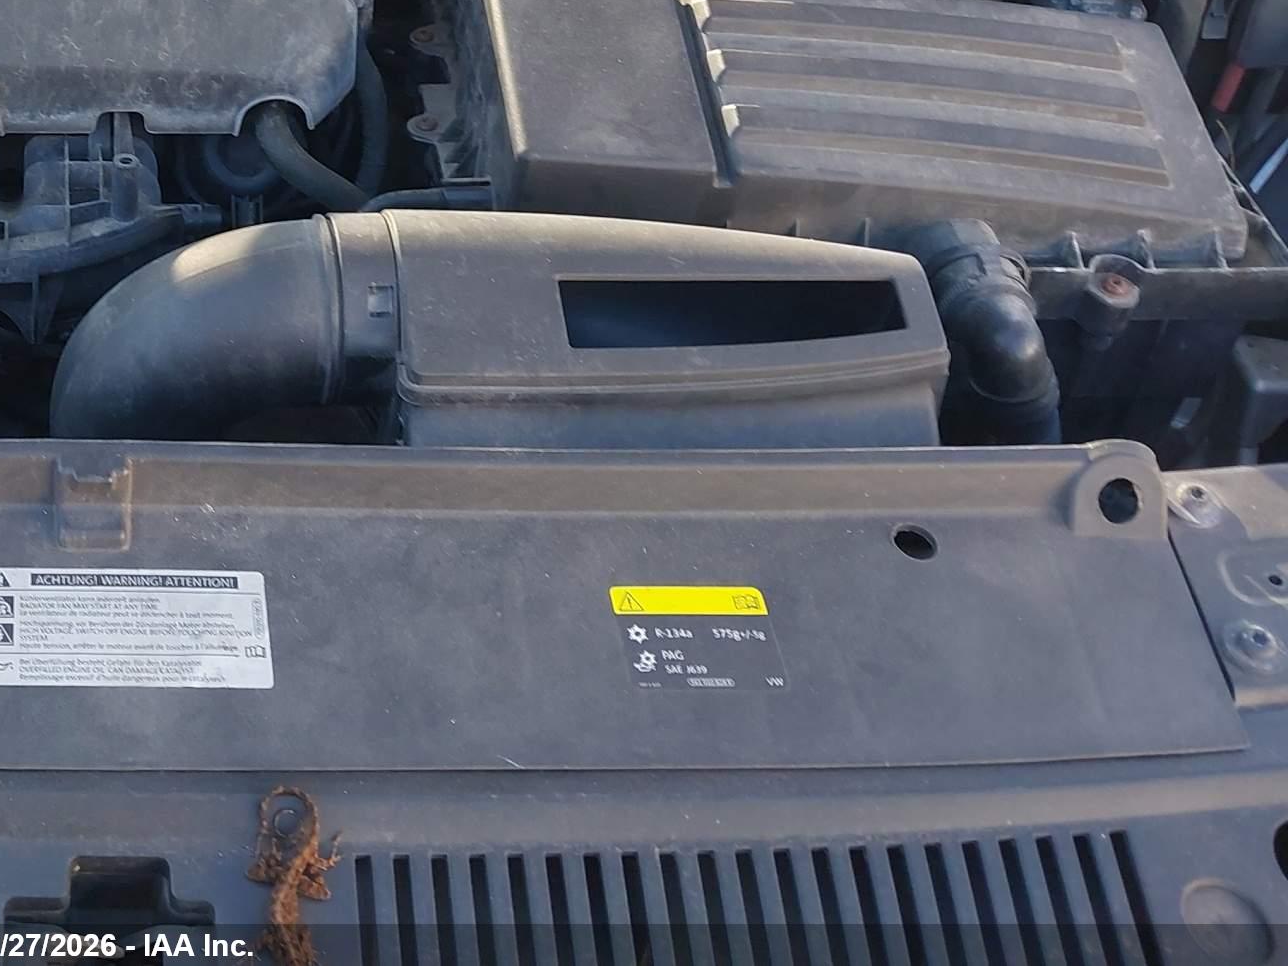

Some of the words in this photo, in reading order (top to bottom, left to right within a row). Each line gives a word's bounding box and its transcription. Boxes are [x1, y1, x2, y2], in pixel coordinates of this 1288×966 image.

[35, 573, 98, 585] ACHTUNG!
[99, 574, 163, 586] WARNING!
[165, 576, 235, 588] ATTENTION!
[662, 649, 685, 661] PAG
